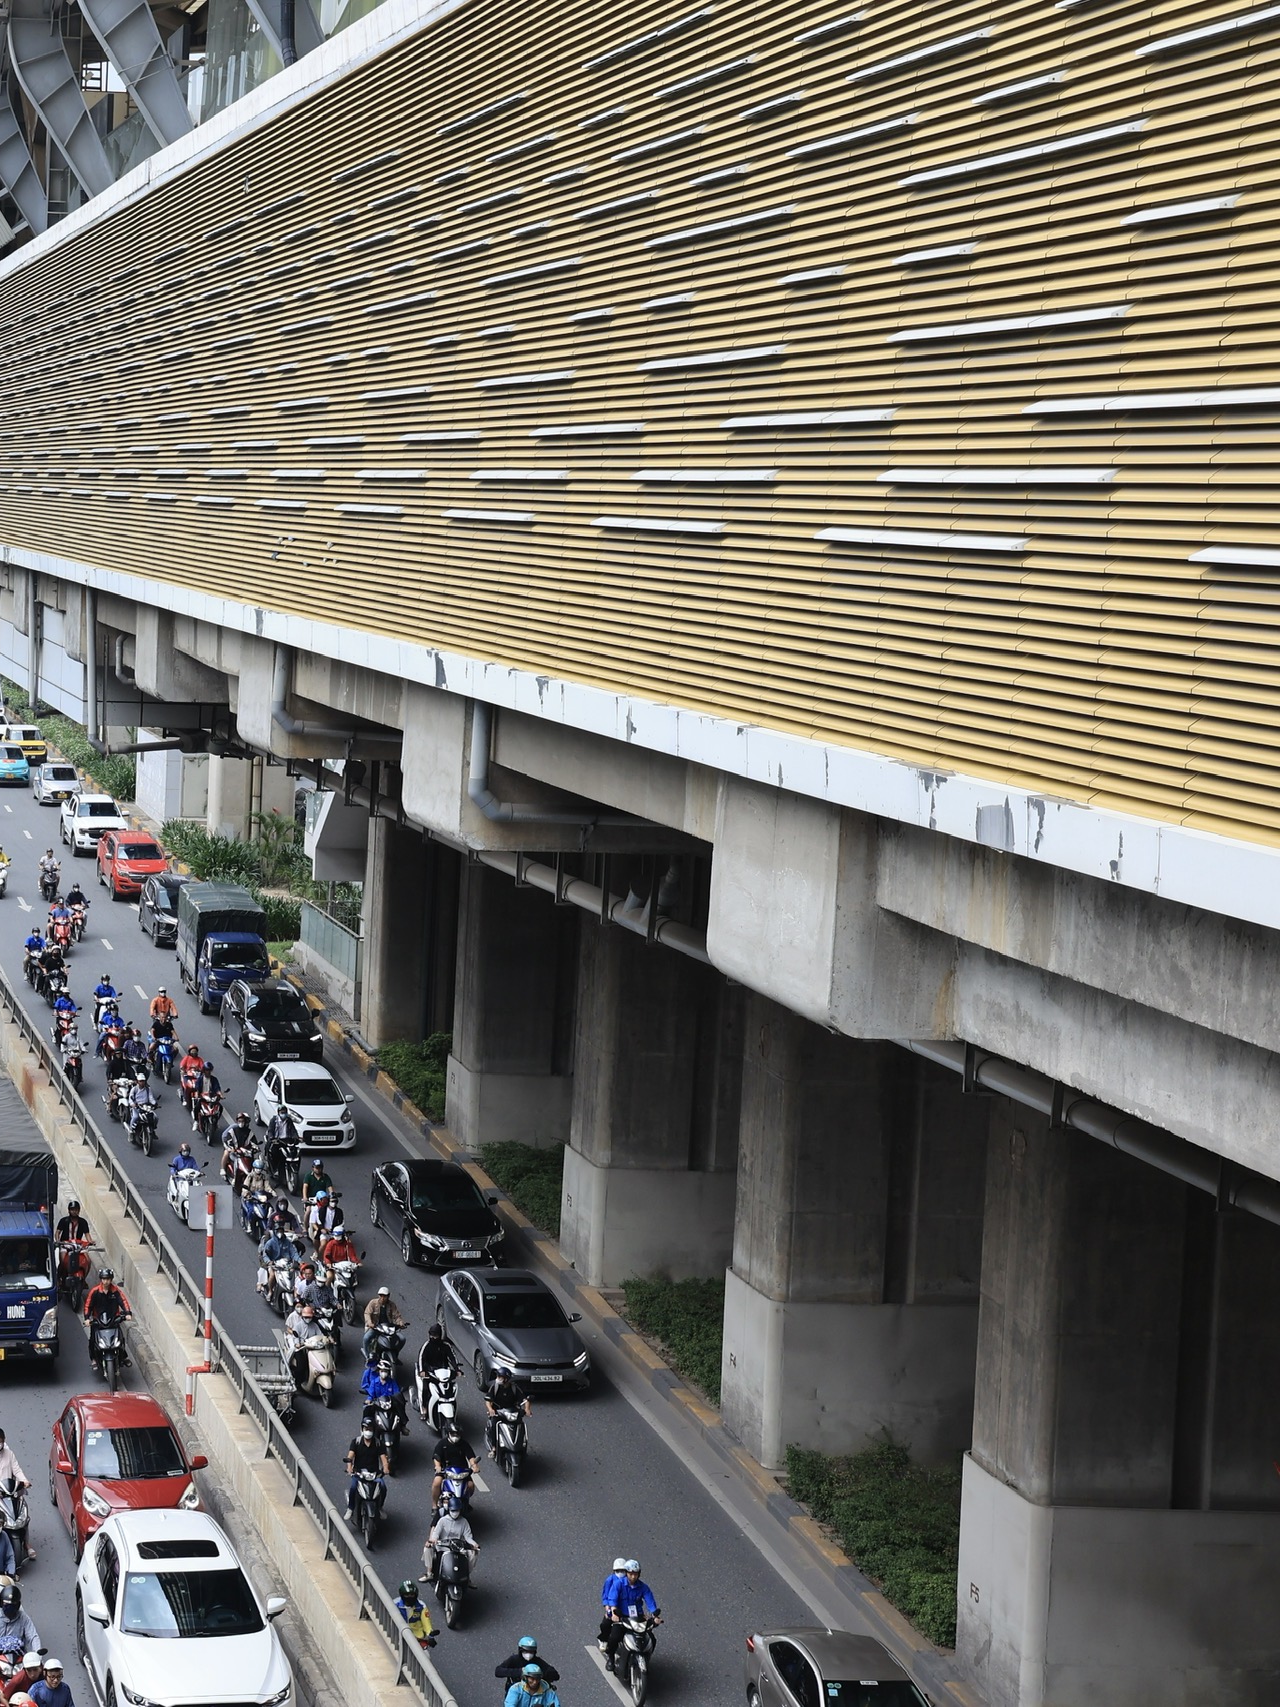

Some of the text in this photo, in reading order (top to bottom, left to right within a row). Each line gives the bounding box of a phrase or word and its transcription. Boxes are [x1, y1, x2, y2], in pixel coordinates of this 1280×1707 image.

[6, 1304, 26, 1319] HƯNG
[729, 1352, 737, 1369] F4
[970, 1582, 980, 1603] F5
